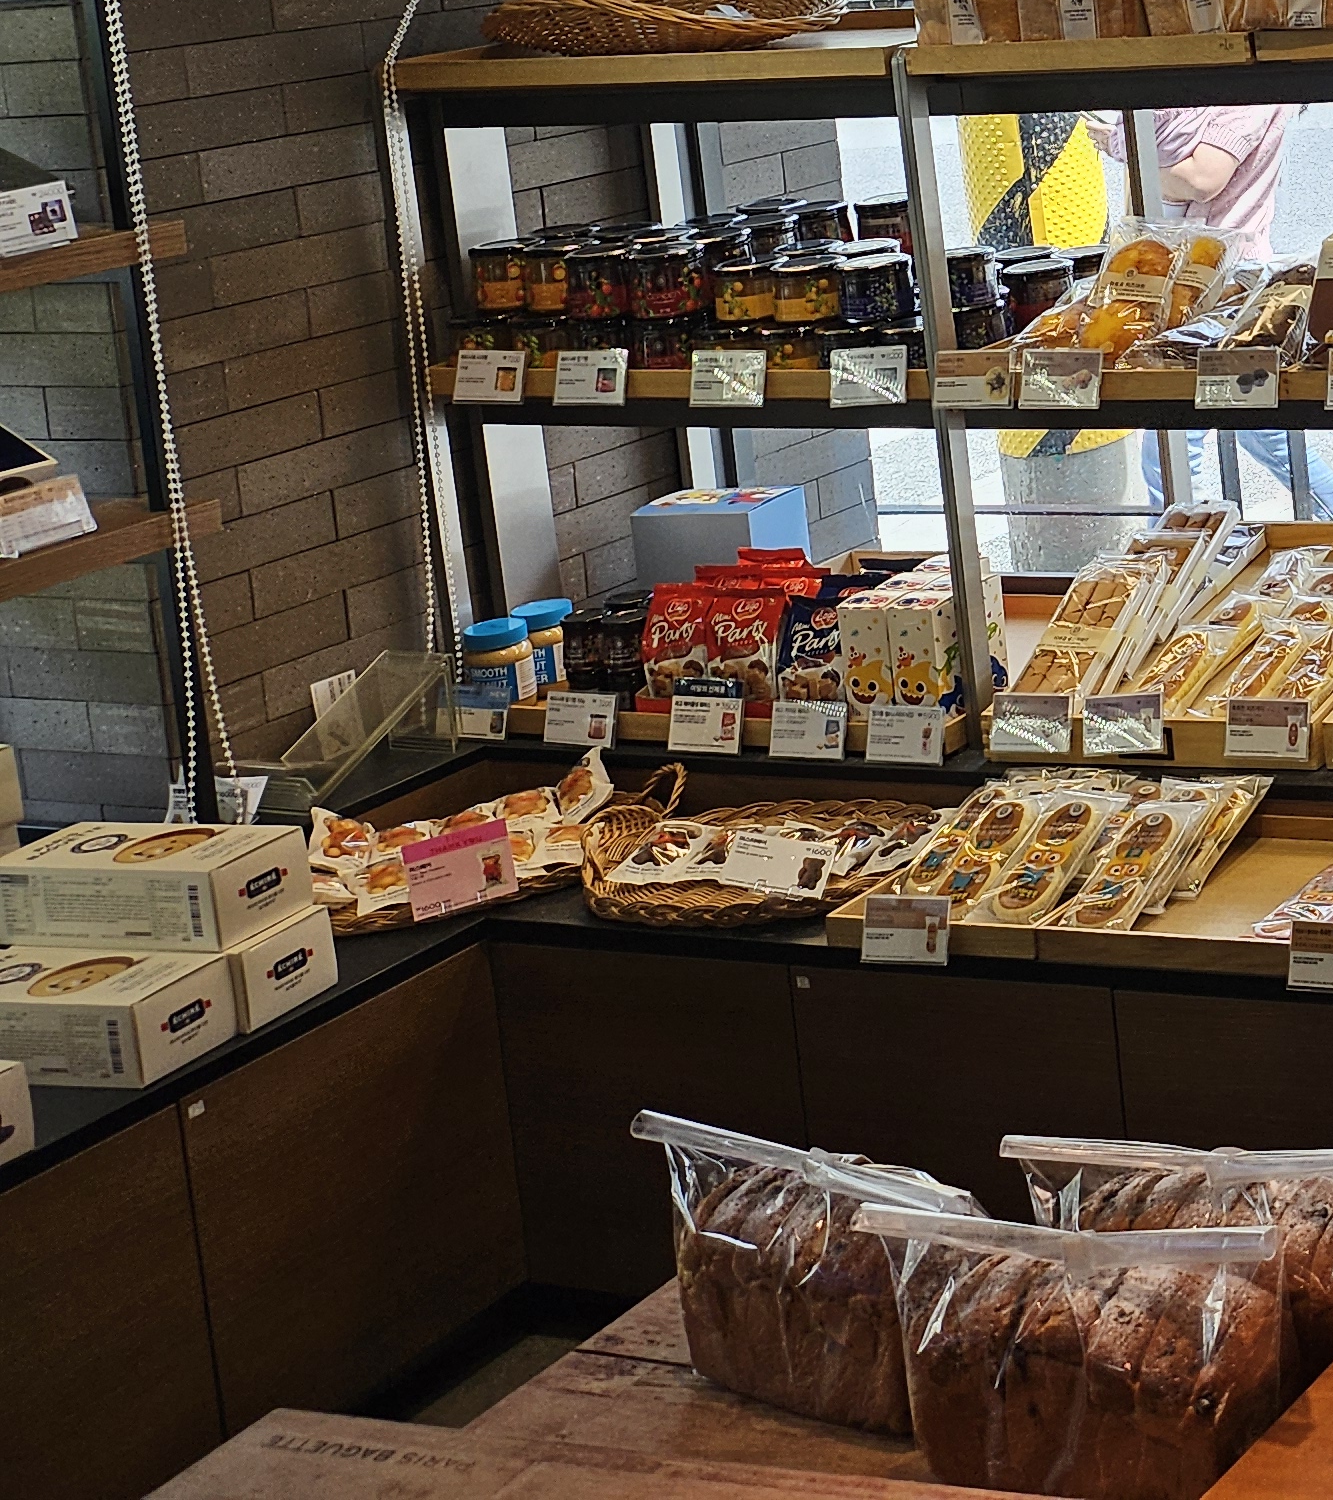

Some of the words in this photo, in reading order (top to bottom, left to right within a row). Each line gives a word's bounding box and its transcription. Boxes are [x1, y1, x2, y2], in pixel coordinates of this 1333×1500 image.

[651, 621, 695, 648] Party
[714, 620, 768, 647] Party
[470, 666, 508, 678] SMOOTH
[260, 1435, 397, 1462] BAGUETTE
